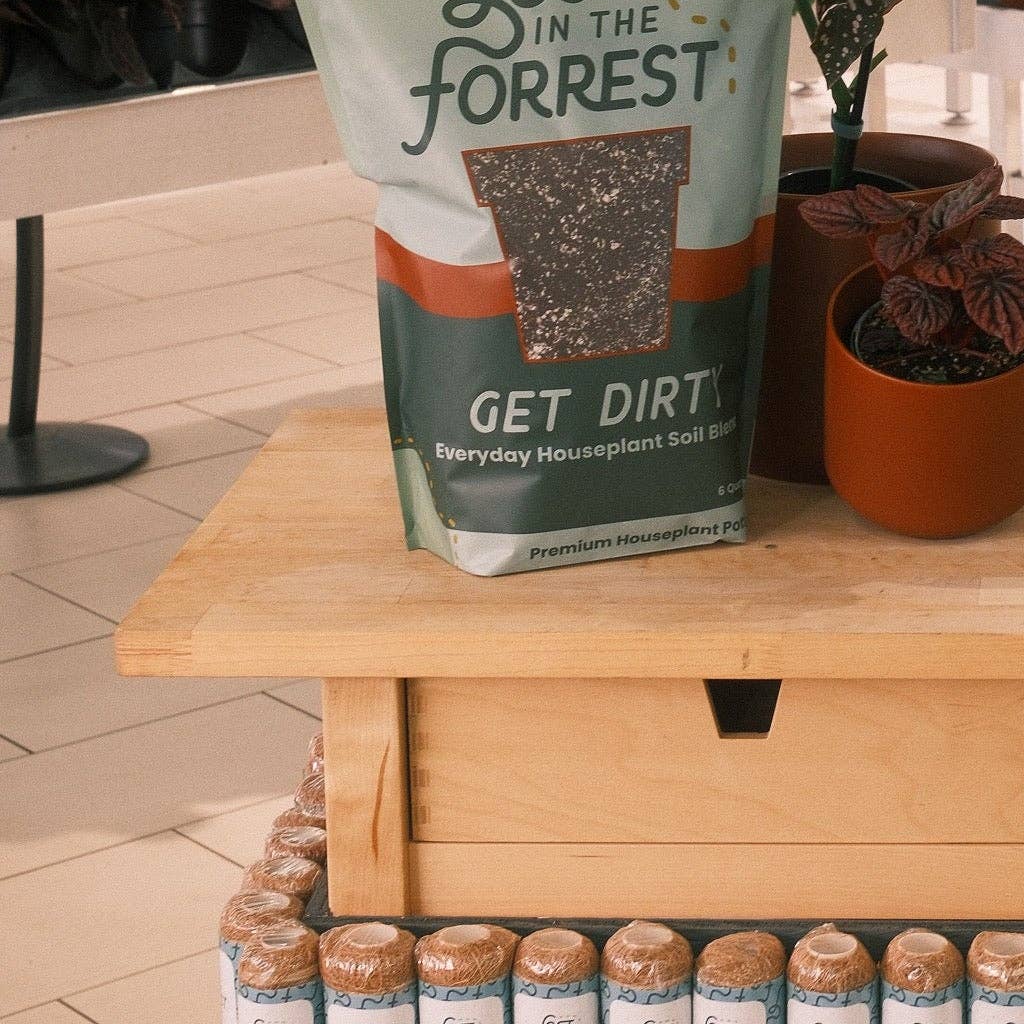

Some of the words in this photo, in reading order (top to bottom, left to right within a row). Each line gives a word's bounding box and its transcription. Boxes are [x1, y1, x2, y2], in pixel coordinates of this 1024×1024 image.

[534, 13, 570, 45] IN
[589, 5, 661, 39] THE
[401, 37, 720, 156] FORREST
[469, 388, 572, 434] GET
[600, 363, 724, 426] DIRTY
[435, 442, 531, 468] Everyday
[537, 435, 663, 463] Houseplant
[668, 427, 704, 447] Soil
[718, 485, 726, 496] 6
[530, 536, 612, 560] Premium
[616, 524, 720, 548] Houseplant
